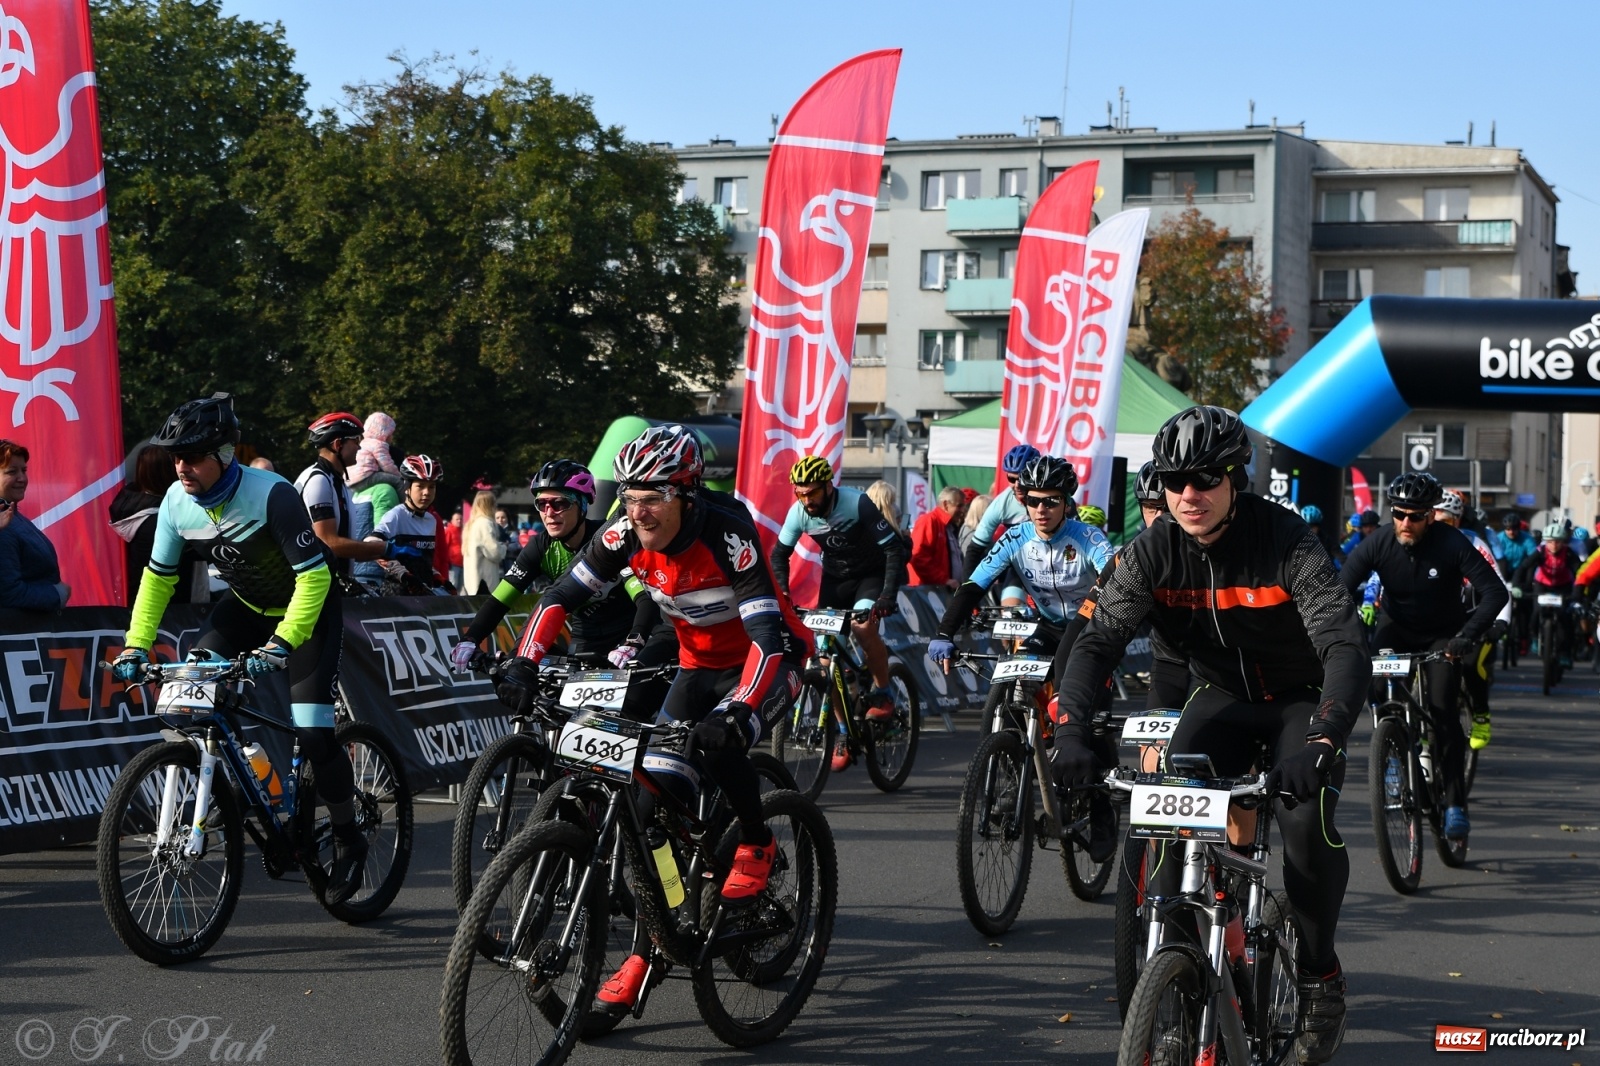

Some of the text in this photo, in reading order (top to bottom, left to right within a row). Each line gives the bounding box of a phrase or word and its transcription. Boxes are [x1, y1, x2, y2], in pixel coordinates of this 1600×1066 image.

[1480, 336, 1574, 381] bike
[811, 617, 836, 627] 1046
[1002, 622, 1029, 631] 1905
[1002, 663, 1039, 674] 2168
[166, 684, 206, 700] 1146
[572, 687, 616, 702] 3068
[573, 734, 624, 762] 1630
[1145, 793, 1211, 818] 2882
